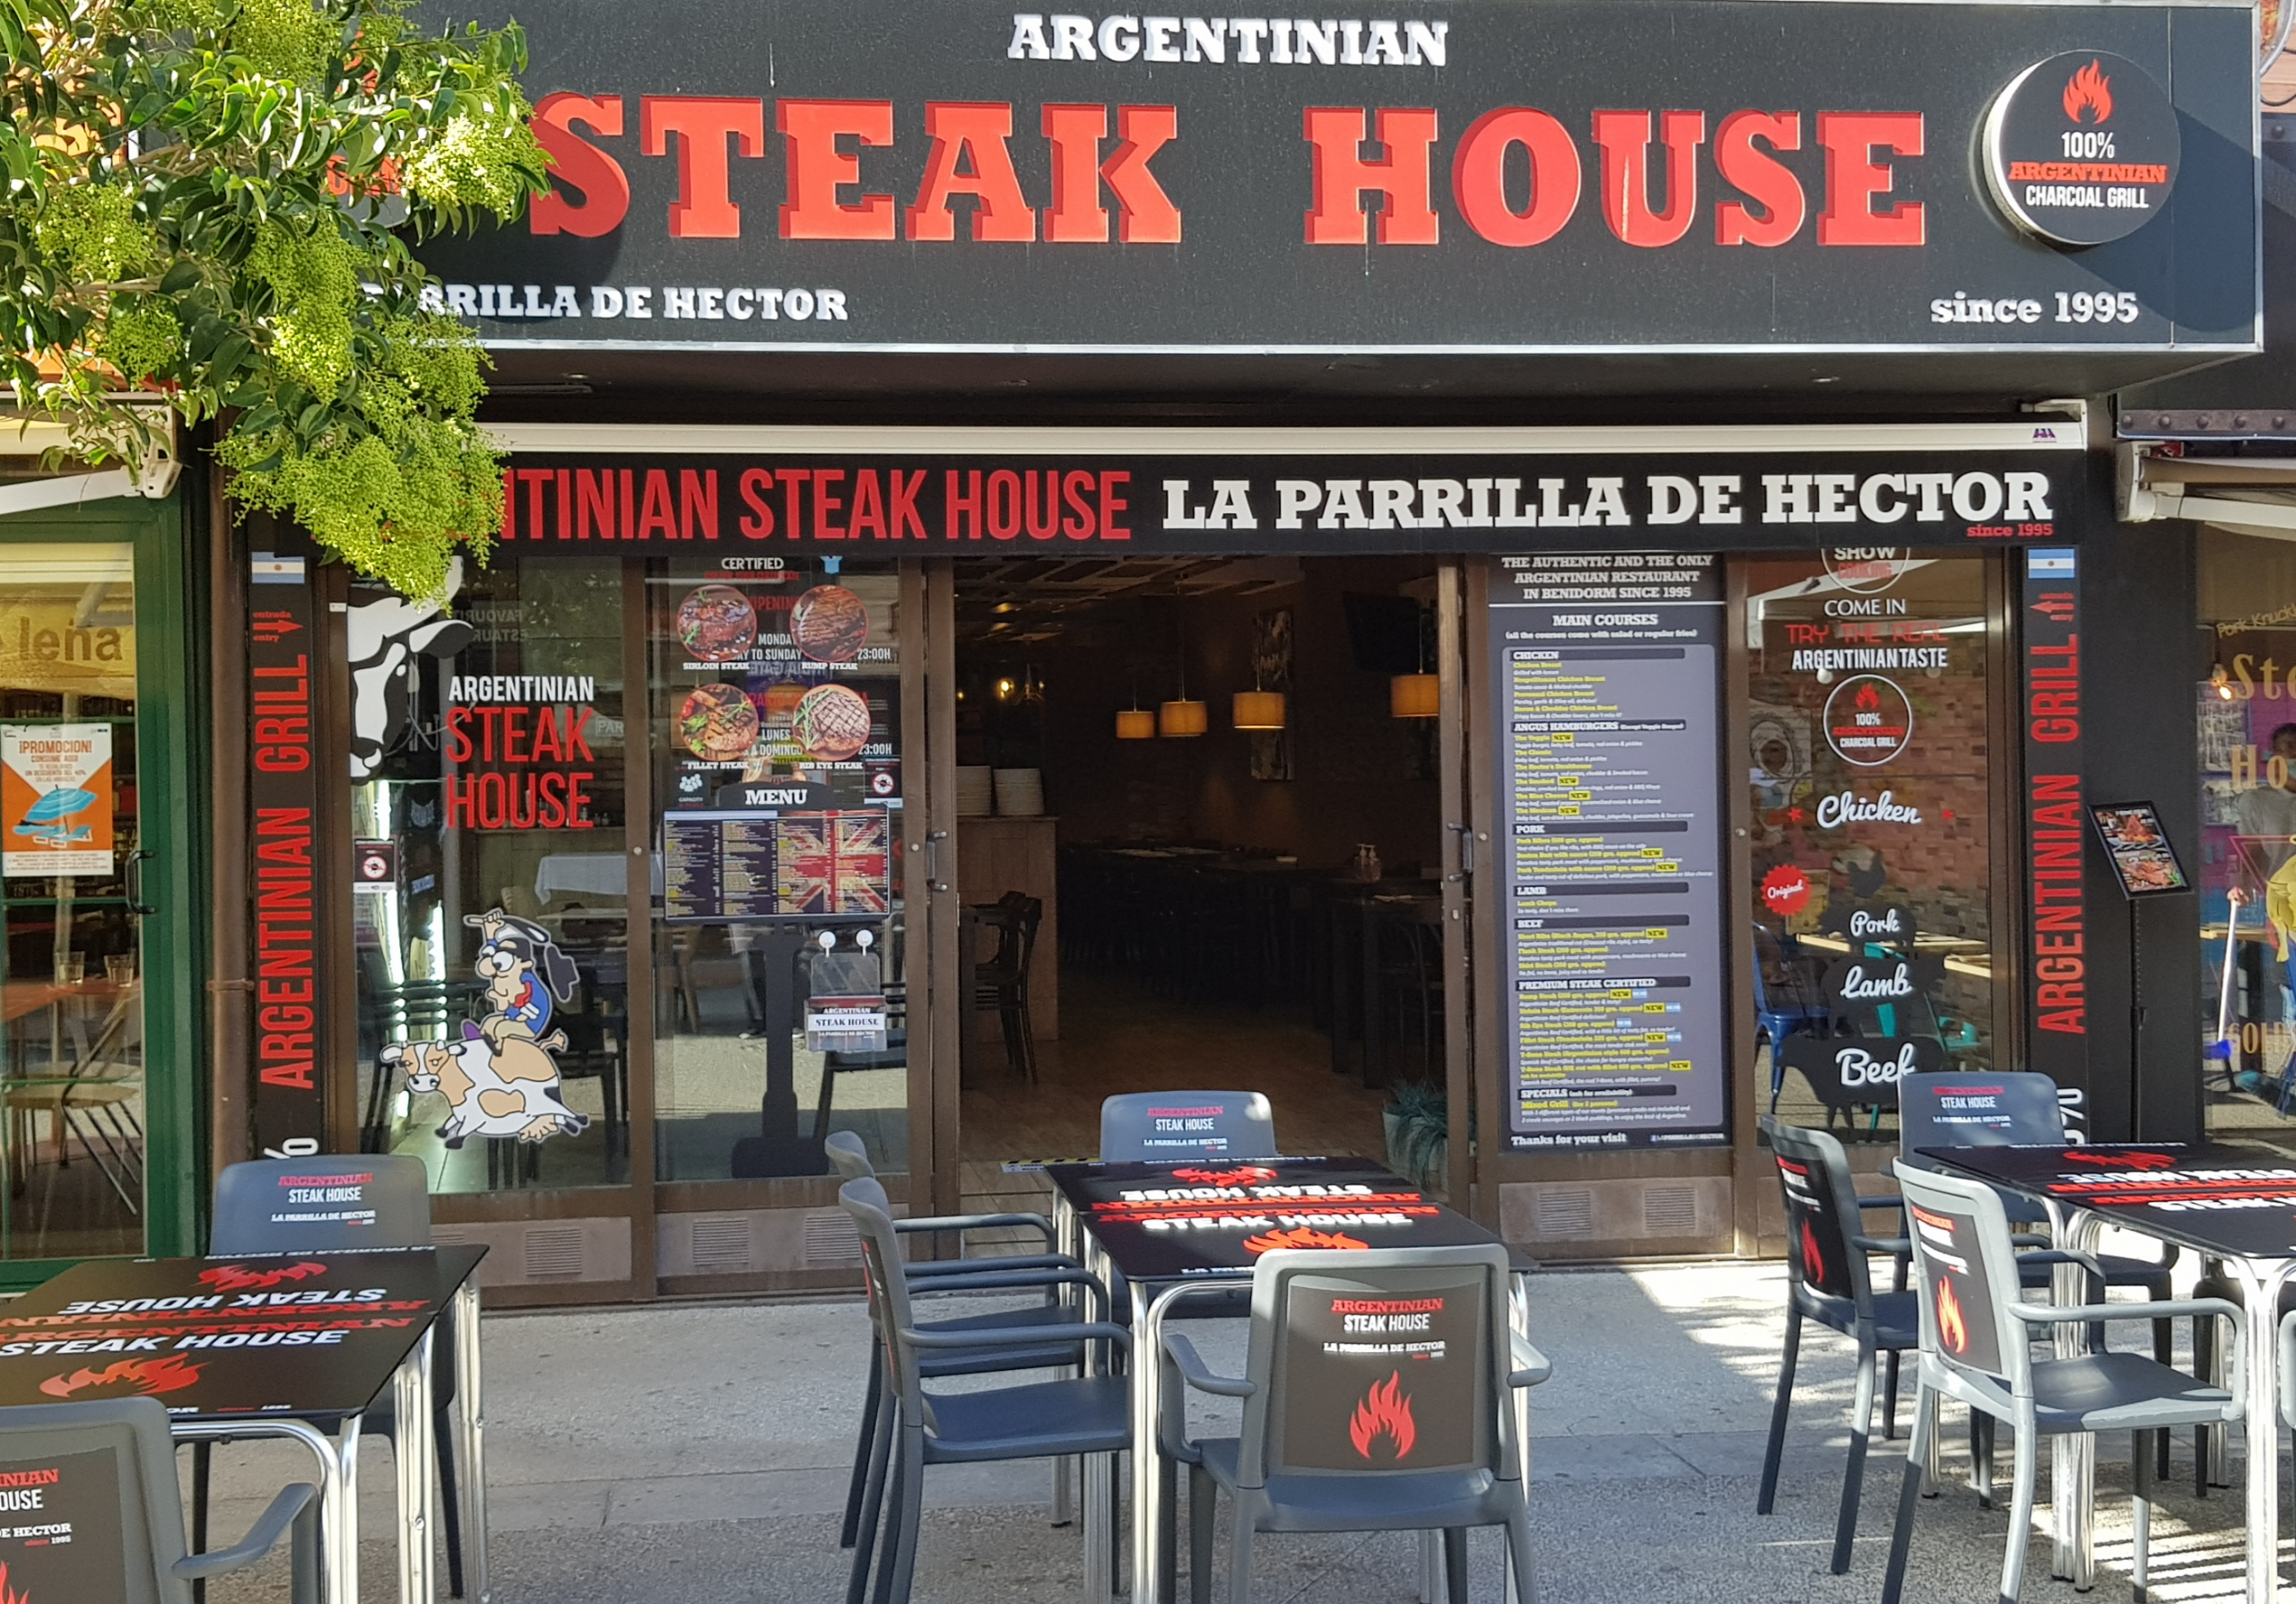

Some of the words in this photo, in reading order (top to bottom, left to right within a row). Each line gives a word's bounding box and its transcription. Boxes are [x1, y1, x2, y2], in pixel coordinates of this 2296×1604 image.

[1007, 13, 1448, 68] ARGENTINIAN
[2062, 132, 2115, 159] 100%
[529, 91, 1181, 244] STEAK
[1304, 106, 1929, 247] HOUSE
[2008, 161, 2168, 183] ARGENTINIAN
[2026, 185, 2105, 207] CHARCOAL
[2107, 187, 2149, 209] GRILL
[591, 285, 652, 320] DE
[664, 285, 848, 323] HECTOR
[1930, 290, 2042, 323] since
[2055, 292, 2139, 323] 1995
[740, 468, 926, 539] STEAK
[946, 469, 1131, 539] HOUSE
[1161, 478, 1257, 530] LA
[1275, 475, 1632, 530] PARRILLA
[1647, 474, 1743, 526] DE
[1761, 471, 2054, 523] HECTOR
[1967, 524, 2013, 537] since
[2018, 523, 2054, 536] 1995
[1501, 557, 1530, 569] THE
[1532, 556, 1613, 569] AUTHENTIC
[1614, 555, 1644, 568] AND
[1646, 555, 1674, 567] THE
[1676, 555, 1713, 567] ONLY
[1834, 547, 1896, 561] SHOW
[721, 557, 784, 570] CERTIFIED
[1514, 571, 1609, 584] ARGENTINIAN
[1612, 571, 1700, 583] RESTAURANT
[1523, 588, 1539, 599] IN
[1541, 587, 1615, 599] BENIDORM
[1619, 587, 1660, 598] SINCE
[1663, 587, 1692, 597] 1995
[1824, 599, 1881, 616] COME
[1886, 598, 1907, 615] IN
[1552, 615, 1592, 627] MAIN
[1594, 614, 1659, 626] COURSES
[1784, 624, 1831, 644] TRY
[1841, 623, 1882, 643] THE
[1892, 622, 1949, 643] REAL
[765, 649, 802, 660] SUNDAY
[1513, 651, 1559, 660] CHICKEN
[1792, 649, 1898, 670] ARGENTINIAN
[1899, 648, 1948, 667] TASTE
[683, 662, 719, 670] SIRLOIN
[720, 662, 750, 670] STEAK
[448, 676, 595, 702] ARGENTINIAN
[2030, 633, 2080, 743] GRILL
[254, 654, 310, 772] GRILL
[1855, 713, 1881, 726] 100%
[447, 707, 595, 763] STEAK
[762, 729, 791, 741] LUNES
[1839, 737, 1875, 748] CHARCOAL
[760, 744, 803, 756] DOMINGO
[687, 762, 718, 770] FILLET
[719, 761, 749, 770] STEAK
[448, 772, 595, 829] HOUSE
[745, 789, 808, 806] MENU
[1816, 790, 1922, 828] Chicken
[1516, 825, 1544, 833] PORK
[1517, 887, 1547, 895] LAMB
[1767, 879, 1804, 900] Original
[2031, 774, 2087, 1034] ARGENTINIAN
[1849, 909, 1901, 937] Pork
[257, 807, 315, 1089] ARGENTINIAN
[1518, 981, 1568, 989] PREMIUM
[1569, 980, 1602, 989] STEAK
[1603, 979, 1657, 988] CERTIFIED
[1839, 963, 1913, 999] Lamb
[815, 1019, 845, 1027] STEAK
[848, 1018, 879, 1026] HOUSE
[1835, 1042, 1917, 1087] Beef
[1521, 1089, 1568, 1099] SPECIALS
[1941, 1096, 1967, 1109] STEAK
[1968, 1096, 1996, 1108] HOUSE
[1155, 1119, 1183, 1131] STEAK
[1186, 1118, 1213, 1130] HOUSE
[1511, 1134, 1553, 1146] Thanks
[1555, 1134, 1571, 1145] for
[1572, 1135, 1599, 1146] your
[1600, 1132, 1627, 1143] visit
[278, 1172, 373, 1186] ARGENTINIAN
[289, 1189, 324, 1203] STEAK
[326, 1186, 361, 1202] HOUSE
[271, 1214, 284, 1222] LA
[341, 1209, 375, 1219] HECTOR
[1142, 1214, 1274, 1230] STEAK
[1278, 1212, 1413, 1227] HOUSE
[1331, 1298, 1443, 1312] ARGENTINIAN
[1344, 1314, 1387, 1332] STEAK
[1388, 1313, 1430, 1331] HOUSE
[0, 1337, 170, 1356] STEAK
[173, 1329, 349, 1350] HOUSE
[1324, 1343, 1337, 1352] LA
[1390, 1343, 1404, 1352] DE
[1405, 1341, 1446, 1352] HECTOR
[0, 1489, 43, 1511] OUSE
[13, 1523, 72, 1538] HECTOR
[51, 1536, 71, 1544] 1995
